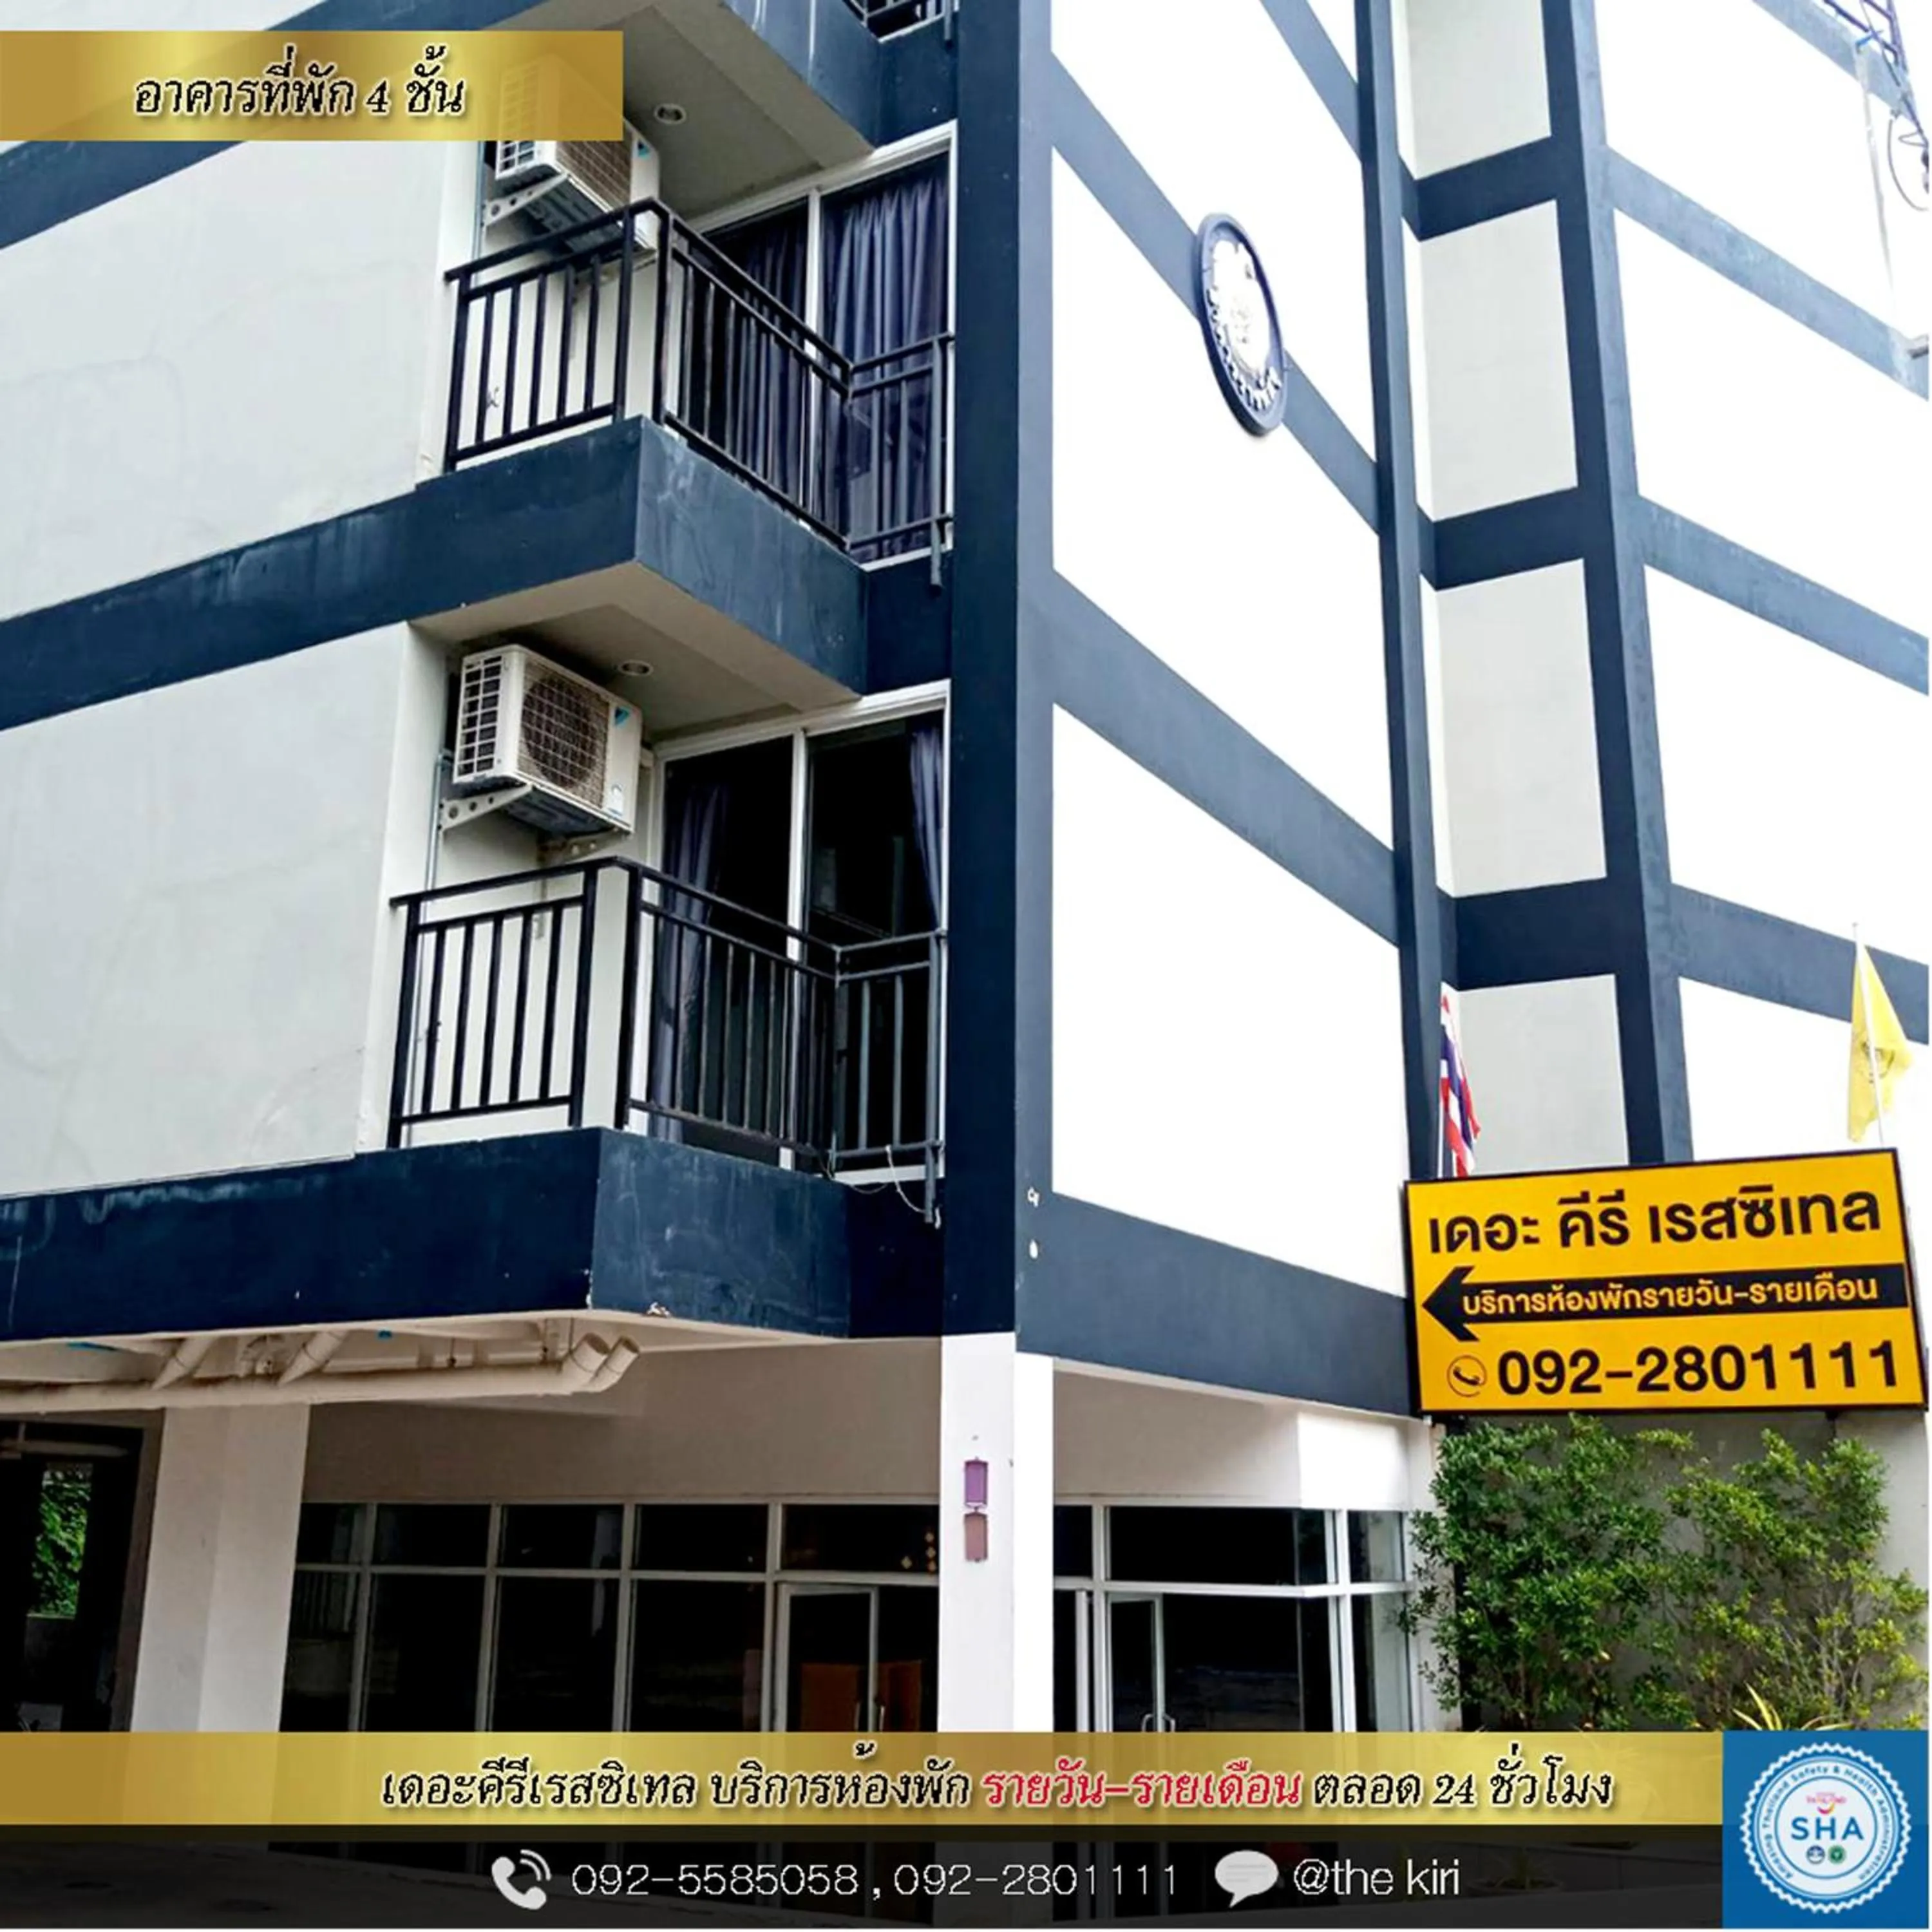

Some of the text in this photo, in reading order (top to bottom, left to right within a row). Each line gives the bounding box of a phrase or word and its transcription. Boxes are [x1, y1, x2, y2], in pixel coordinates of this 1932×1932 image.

[1429, 1184, 1880, 1253] เดอะ คีรี เรสซิเทล
[1463, 1271, 1878, 1315] บริการห้องพักรายวัน-รายเดือน
[1497, 1340, 1897, 1396] 092-2801111
